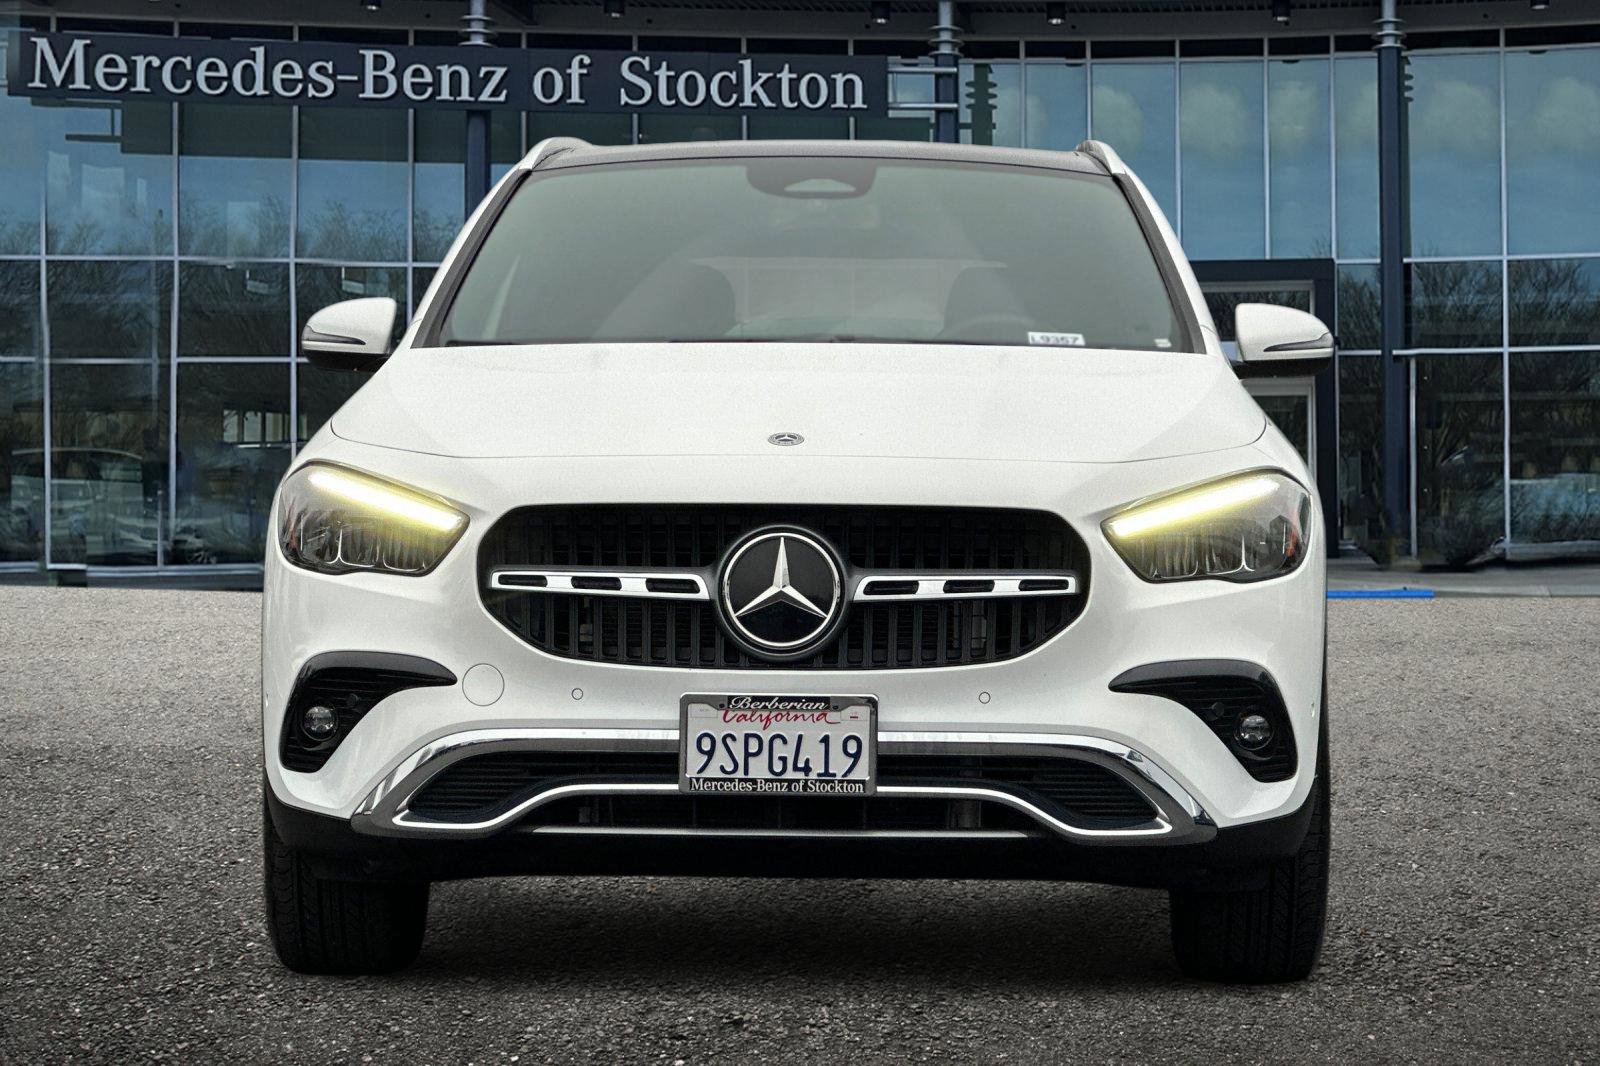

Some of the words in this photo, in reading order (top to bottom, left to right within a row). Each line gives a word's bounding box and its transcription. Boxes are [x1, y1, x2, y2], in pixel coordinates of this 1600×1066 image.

[28, 37, 508, 101] Mercedes-Benz
[532, 54, 591, 103] of
[620, 56, 867, 108] Stockton
[730, 696, 828, 710] Berberian
[722, 709, 841, 730] California
[696, 732, 863, 777] 9SPG419
[690, 778, 788, 792] Mercedes-Benz
[791, 780, 804, 793] of
[807, 781, 864, 793] Stockton
